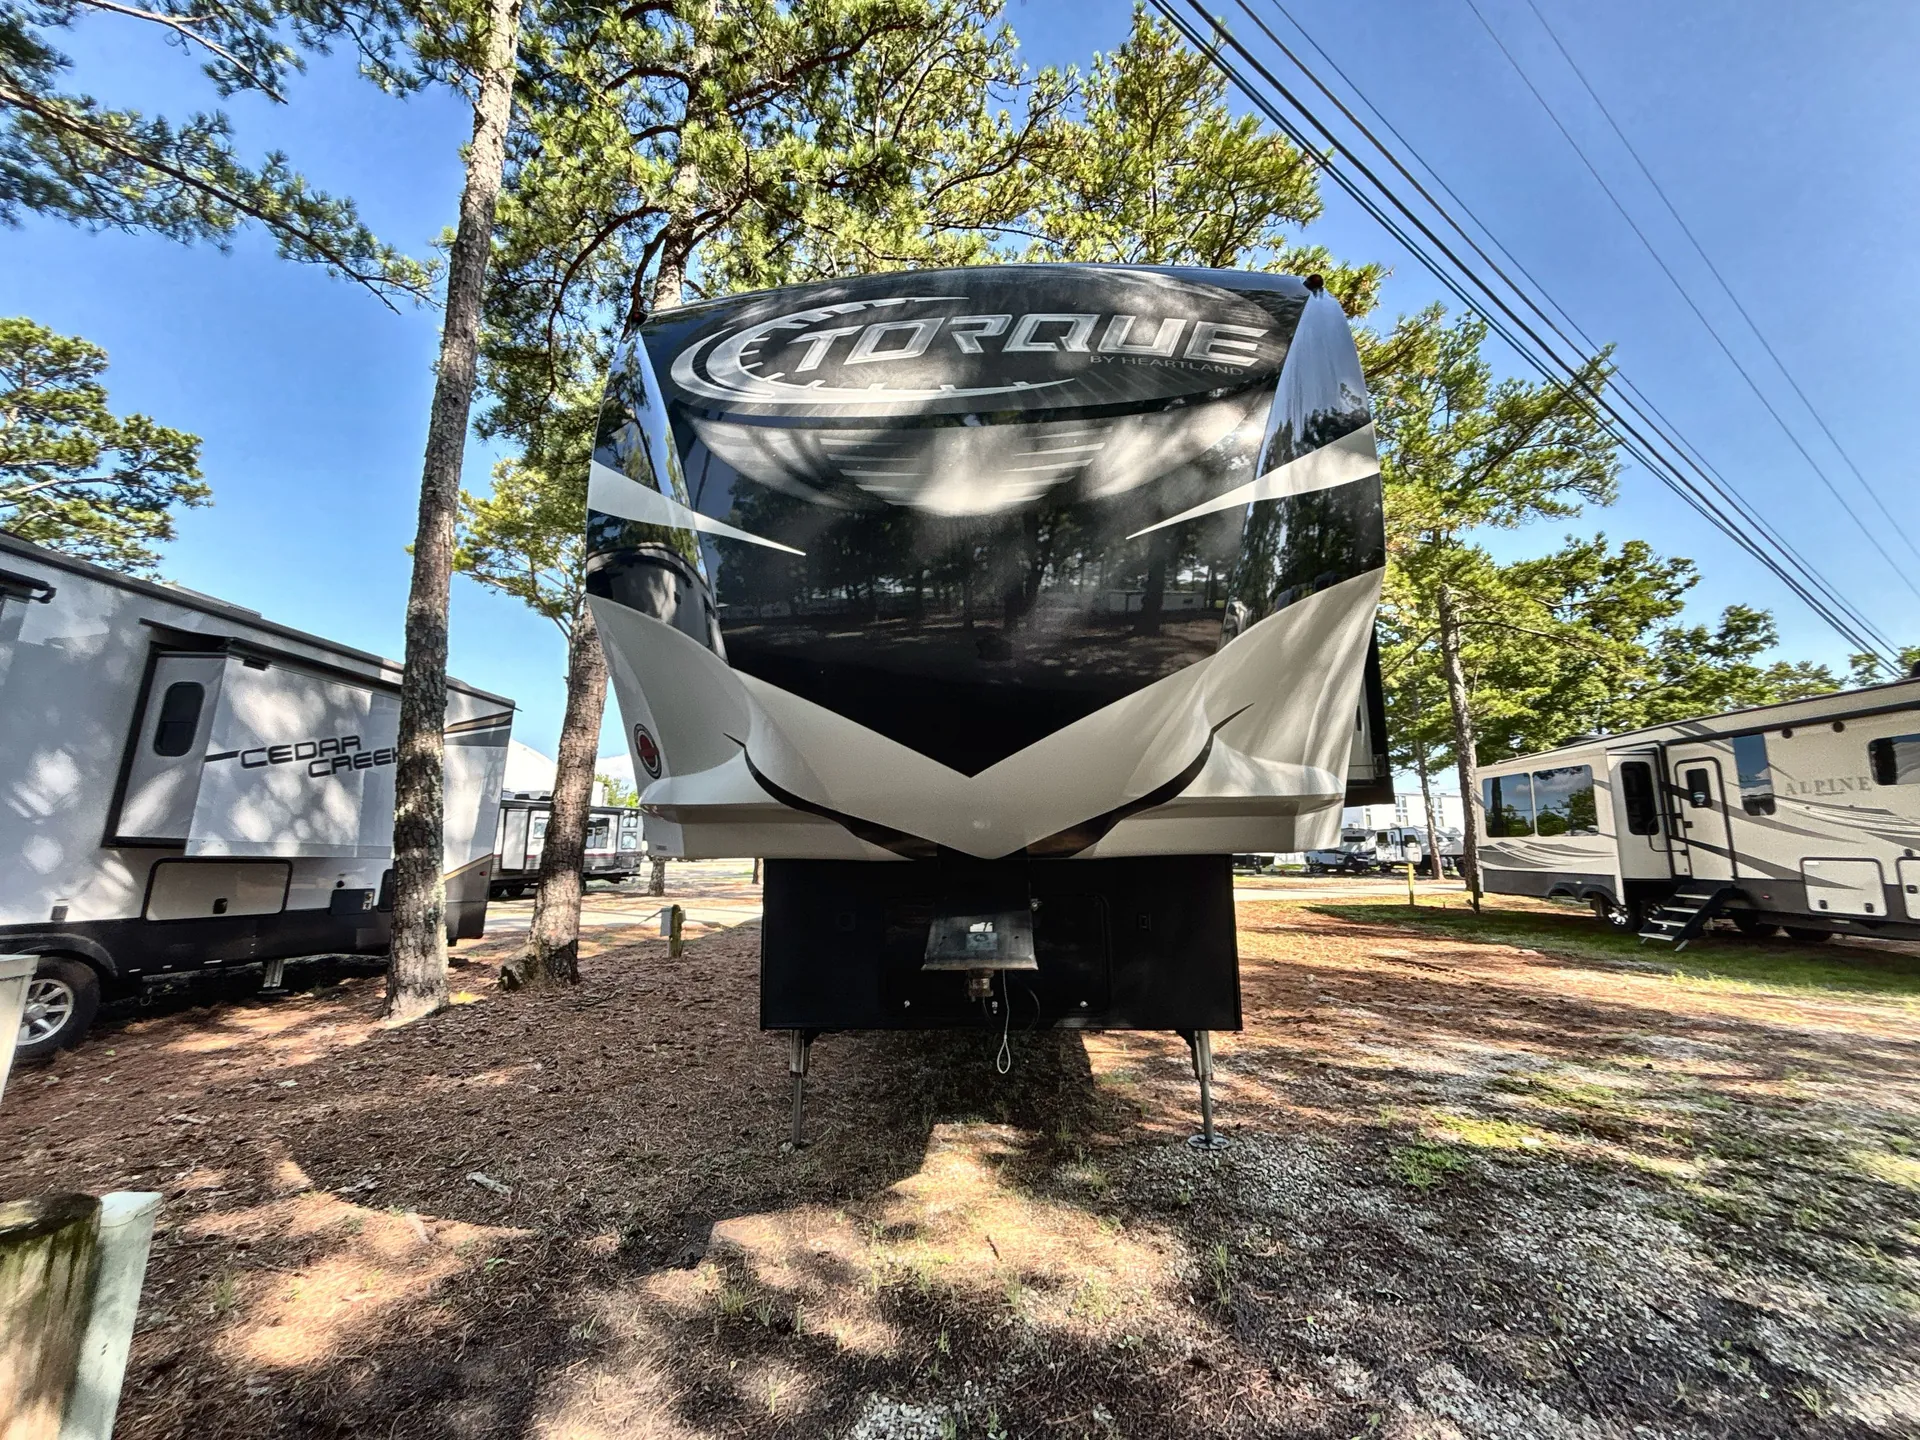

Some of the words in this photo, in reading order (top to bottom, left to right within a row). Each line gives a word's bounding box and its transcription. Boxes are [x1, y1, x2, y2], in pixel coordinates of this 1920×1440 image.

[787, 313, 1269, 372] TORQUE
[1090, 355, 1115, 364] BY
[1121, 356, 1245, 376] HEARTLAND
[240, 735, 362, 769] CEDAR
[1785, 776, 1873, 796] ALPINE
